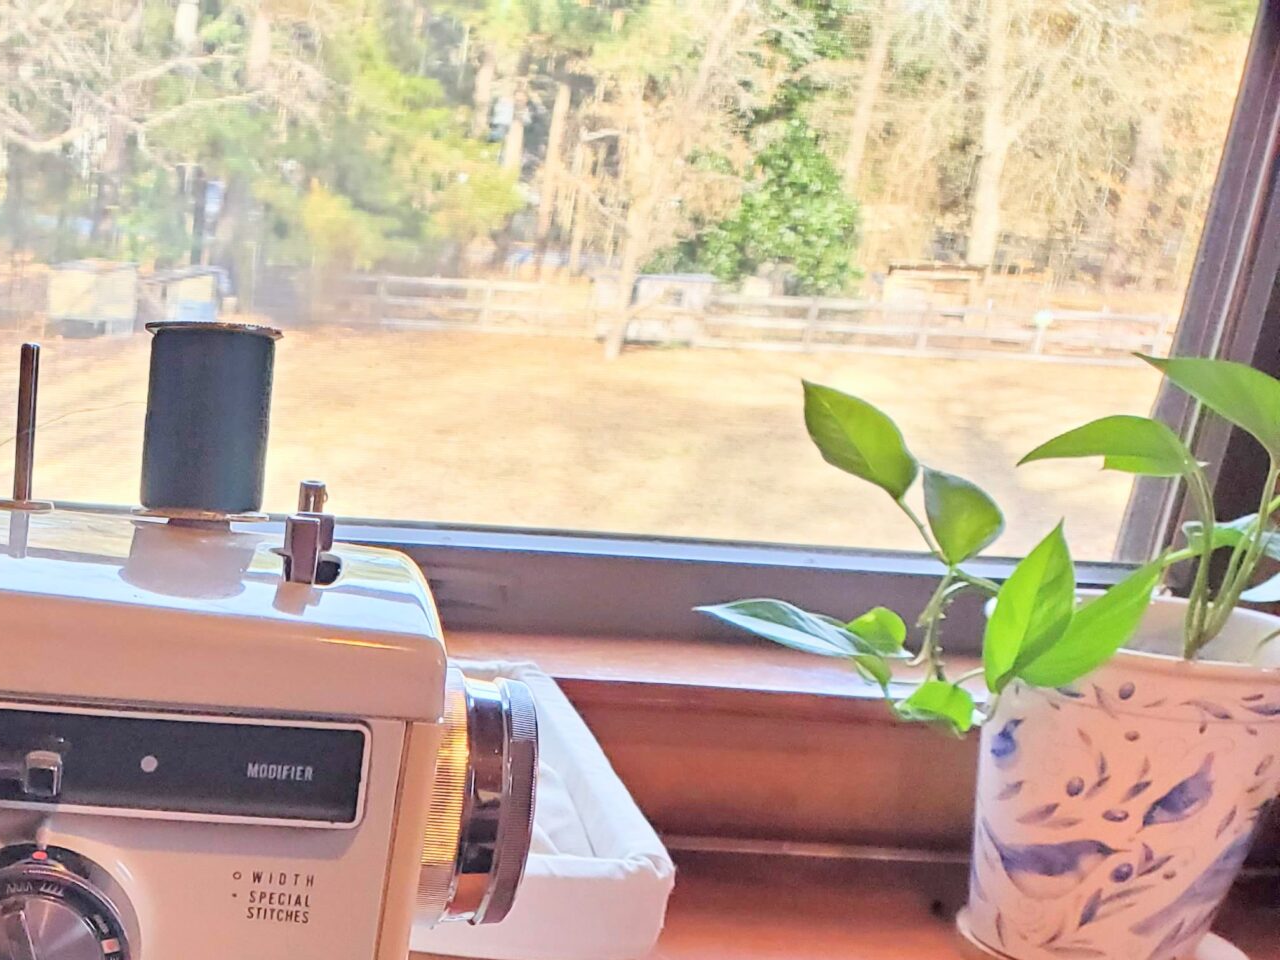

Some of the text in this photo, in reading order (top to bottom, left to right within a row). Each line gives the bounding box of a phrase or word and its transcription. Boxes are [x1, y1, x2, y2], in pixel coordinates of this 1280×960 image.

[246, 761, 314, 781] MODIFIER
[252, 871, 315, 887] WIDTH
[248, 890, 311, 908] SPECIAL
[246, 906, 310, 924] STITCHES
